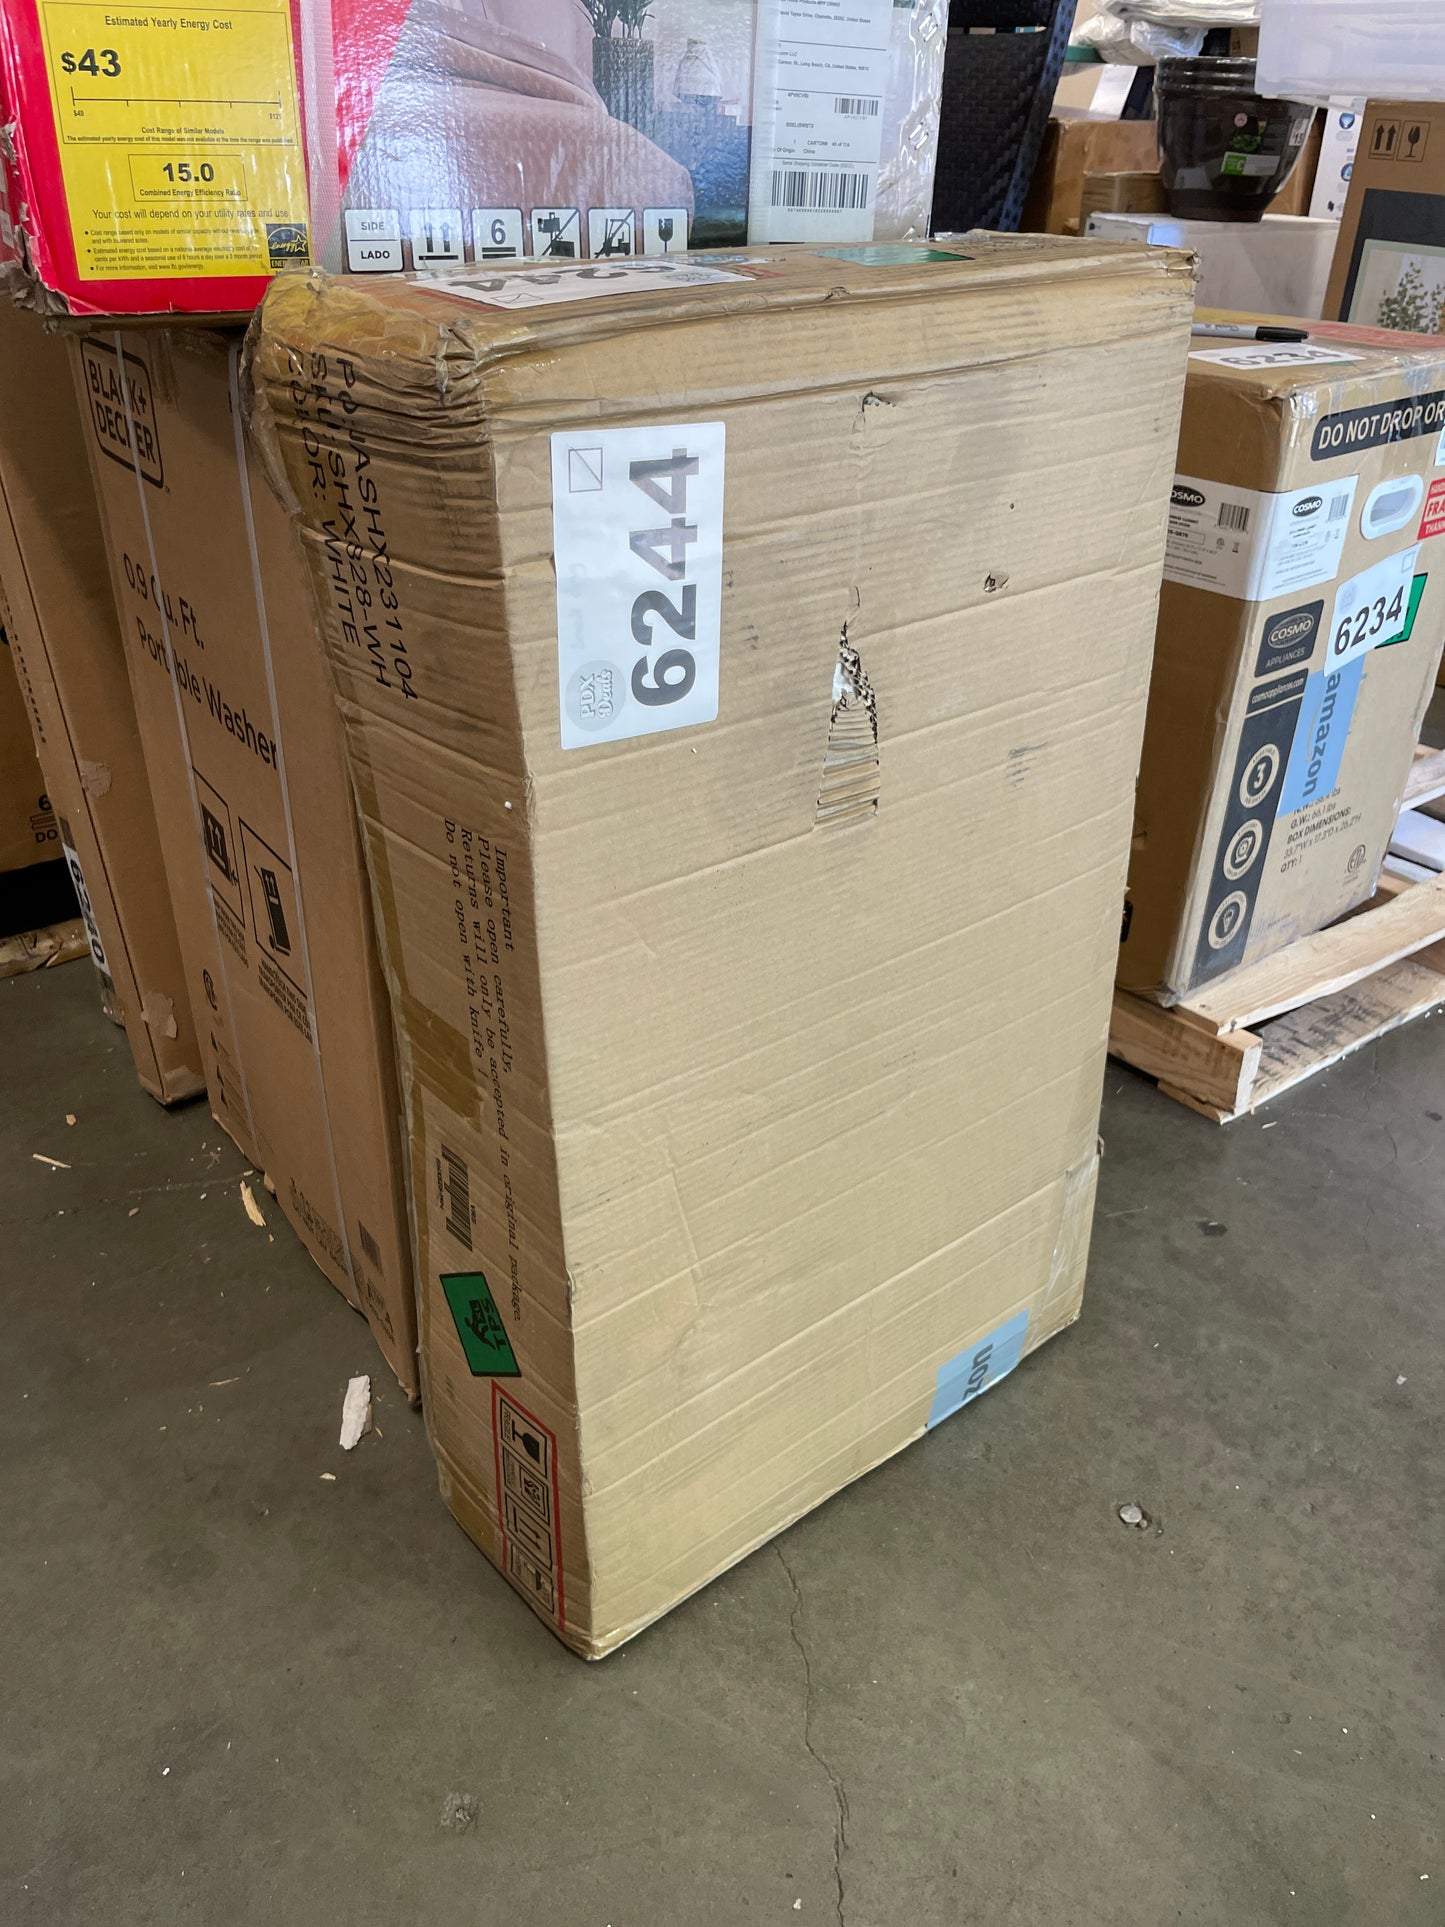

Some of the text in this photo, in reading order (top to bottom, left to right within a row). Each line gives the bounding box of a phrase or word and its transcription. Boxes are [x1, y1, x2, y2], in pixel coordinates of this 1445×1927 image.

[105, 15, 233, 31] Estimated Yearly Energy Cost
[61, 48, 122, 77] $43
[156, 127, 175, 135] Range
[162, 162, 215, 182] 15.0
[139, 188, 171, 196] Combined
[171, 188, 194, 197] Energy
[194, 188, 224, 197] Efficiency
[92, 208, 289, 220] Your cost will depend on your utility rates and use
[361, 221, 385, 231] SIDE
[490, 217, 506, 245] 6
[360, 250, 391, 260] LADO
[1219, 349, 1341, 366] 6234
[1317, 421, 1344, 451] DO
[1344, 412, 1383, 445] NOT
[1379, 406, 1423, 437] DROP
[1171, 489, 1204, 505] OSMO
[1293, 498, 1322, 514] COSMO
[321, 519, 362, 649] WHITE
[327, 450, 393, 689] SHX828-WH
[628, 447, 700, 708] 6244
[123, 553, 149, 600] 0.9
[178, 596, 205, 650] Ft.
[1334, 585, 1404, 656] 6234
[1270, 618, 1312, 643] COSMO
[1265, 646, 1306, 669] APPLIANCES
[579, 671, 596, 720] PDX
[595, 668, 615, 720] Deals
[202, 676, 278, 771] Washer
[1302, 672, 1342, 798] amazon
[1253, 762, 1267, 790] 3
[444, 817, 456, 844] Do
[1287, 806, 1352, 845] BOX DIMENSIONS:
[449, 853, 463, 888] not
[461, 826, 480, 910] Returns
[1280, 859, 1297, 873] QTY:
[478, 834, 494, 908] Please
[487, 918, 500, 965] open
[495, 845, 515, 953] Important
[456, 899, 468, 945] open
[472, 920, 488, 965] will
[463, 955, 478, 997] with
[480, 975, 494, 1020] only
[469, 1006, 485, 1059] knife
[486, 1026, 496, 1050] be
[489, 1056, 508, 1142] accepted
[499, 1146, 509, 1166] in
[503, 1174, 520, 1251] original
